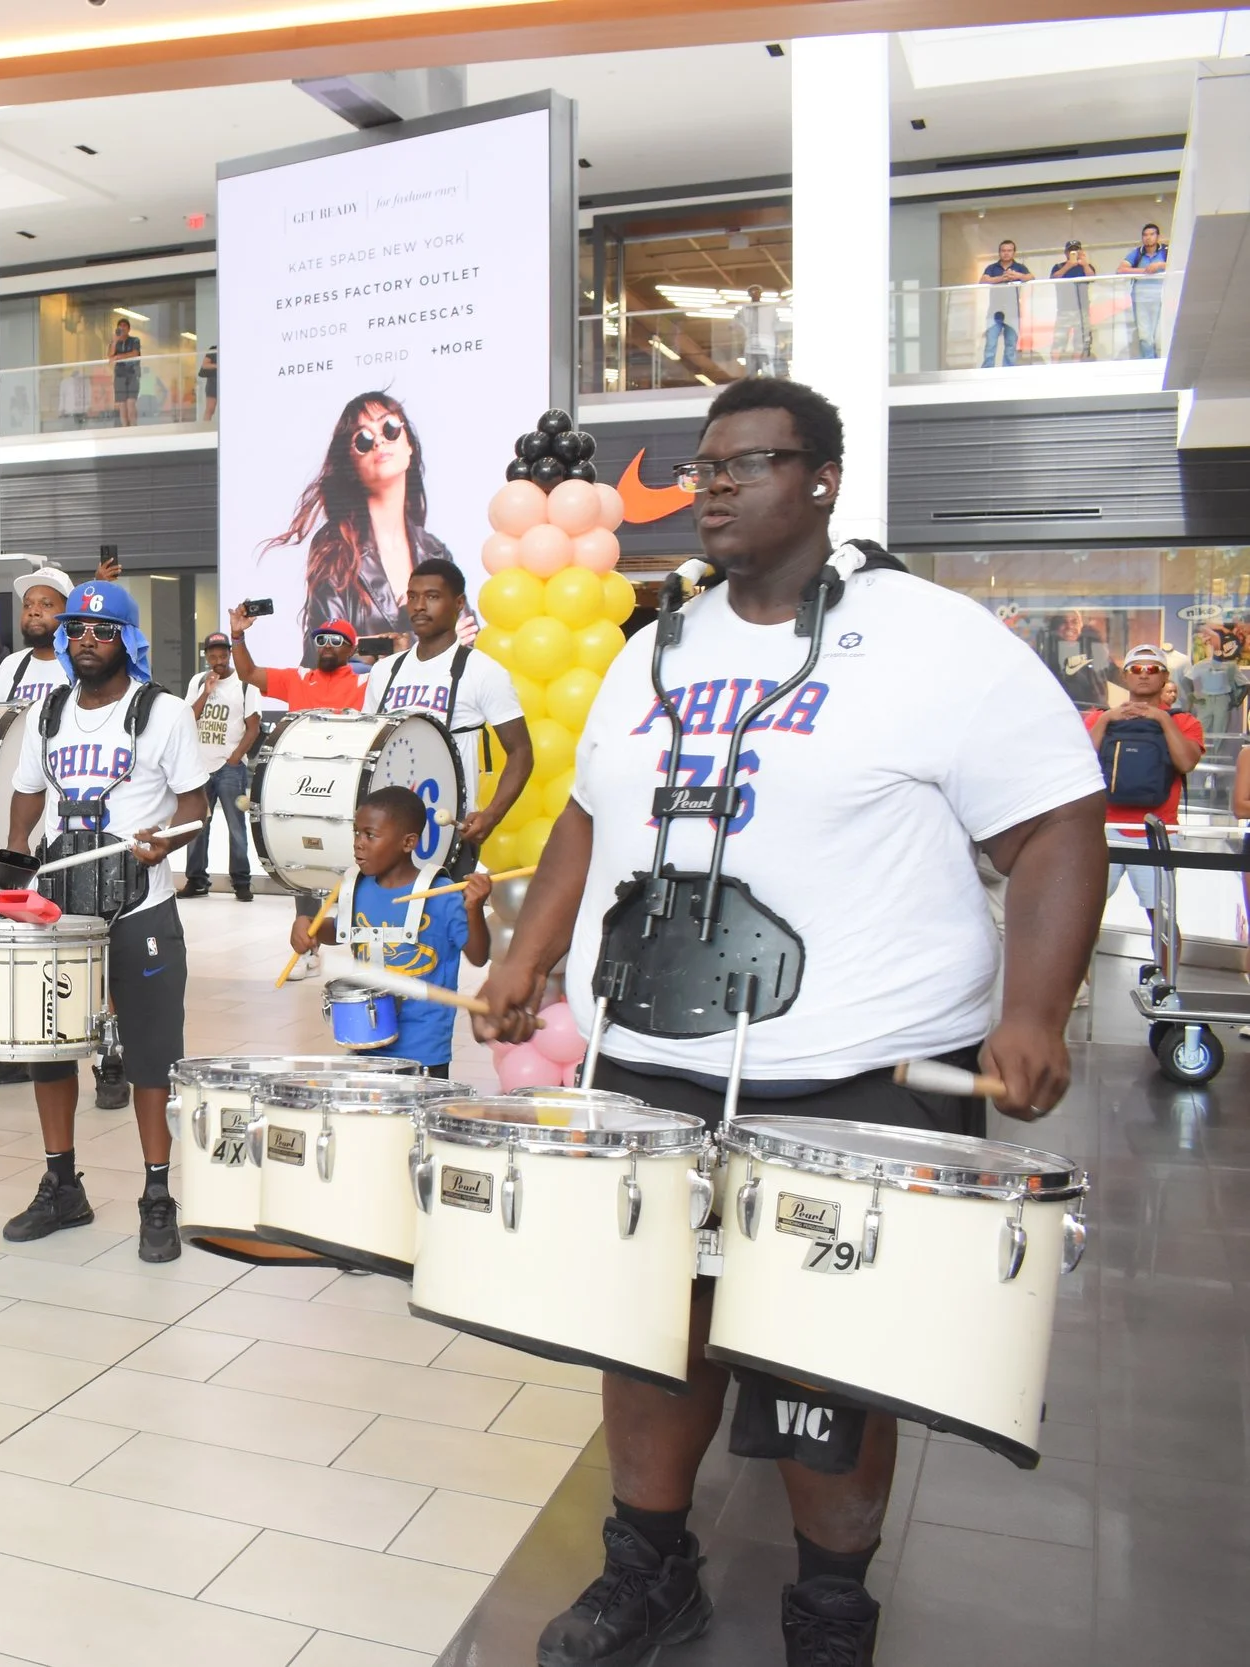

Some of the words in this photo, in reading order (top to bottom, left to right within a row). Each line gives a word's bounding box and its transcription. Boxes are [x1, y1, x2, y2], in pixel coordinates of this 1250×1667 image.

[293, 211, 316, 224] GET
[320, 202, 358, 219] READY
[288, 257, 323, 273] KATE
[330, 248, 376, 267] SPADE
[383, 241, 417, 257] NEW
[424, 232, 465, 249] YORK
[276, 290, 338, 310] EXPRESS
[345, 278, 412, 299] FACTORY
[419, 267, 480, 286] OUTLET
[281, 322, 347, 342] WINDSOR
[368, 304, 474, 329] FRANCESCA'S
[278, 360, 334, 376] ARDENE
[355, 349, 409, 367] TORRID
[431, 339, 484, 355] +MORE
[80, 594, 103, 612] 76
[13, 683, 53, 700] PHIL
[385, 685, 449, 713] PHILA
[204, 704, 230, 721] GOD
[629, 678, 830, 736] PHILA
[213, 733, 226, 745] ME
[49, 744, 132, 782] PHILA
[291, 775, 335, 796] Pearl
[663, 789, 716, 812] Pearl
[410, 778, 440, 860] 6
[43, 964, 72, 1040] Pearl
[272, 1131, 296, 1148] Pearl
[449, 1172, 481, 1192] Pearl
[786, 1201, 827, 1221] Pearl
